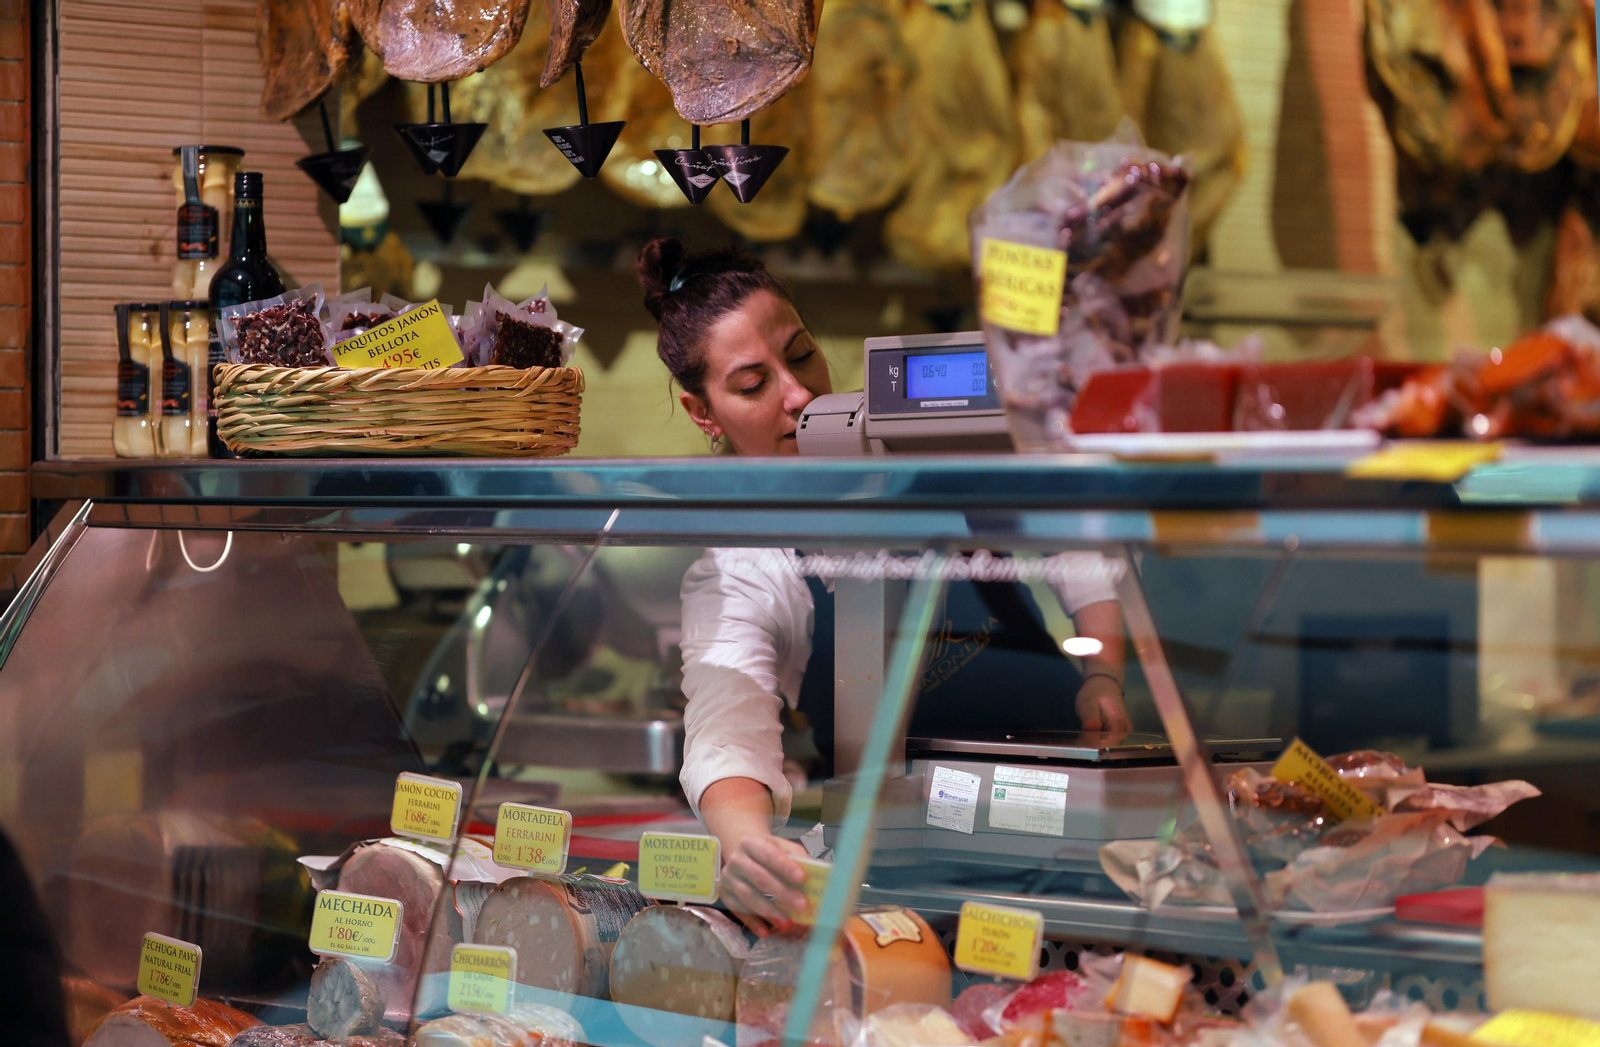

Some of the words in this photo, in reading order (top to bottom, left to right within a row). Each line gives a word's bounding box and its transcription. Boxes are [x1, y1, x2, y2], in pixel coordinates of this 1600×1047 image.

[334, 324, 396, 356] TAQUITOS
[397, 304, 439, 332] JAMÓN
[367, 330, 420, 359] BELLOTA
[888, 365, 899, 378] kg
[890, 380, 897, 392] T
[396, 781, 422, 795] JAMÓN
[423, 787, 458, 801] COCIDO
[407, 798, 441, 811] FERRARINI
[502, 808, 564, 827] MORTADELA
[506, 827, 556, 843] FERRARINI
[643, 838, 709, 851] MORTADELA
[653, 854, 672, 862] CON
[673, 855, 698, 863] TRUFA
[319, 896, 393, 918] MECHADA
[334, 916, 344, 924] AL
[345, 918, 373, 928] HORNO
[142, 938, 177, 957] PECHUGA
[144, 955, 173, 970] NATURAL
[174, 963, 191, 976] FRIAL
